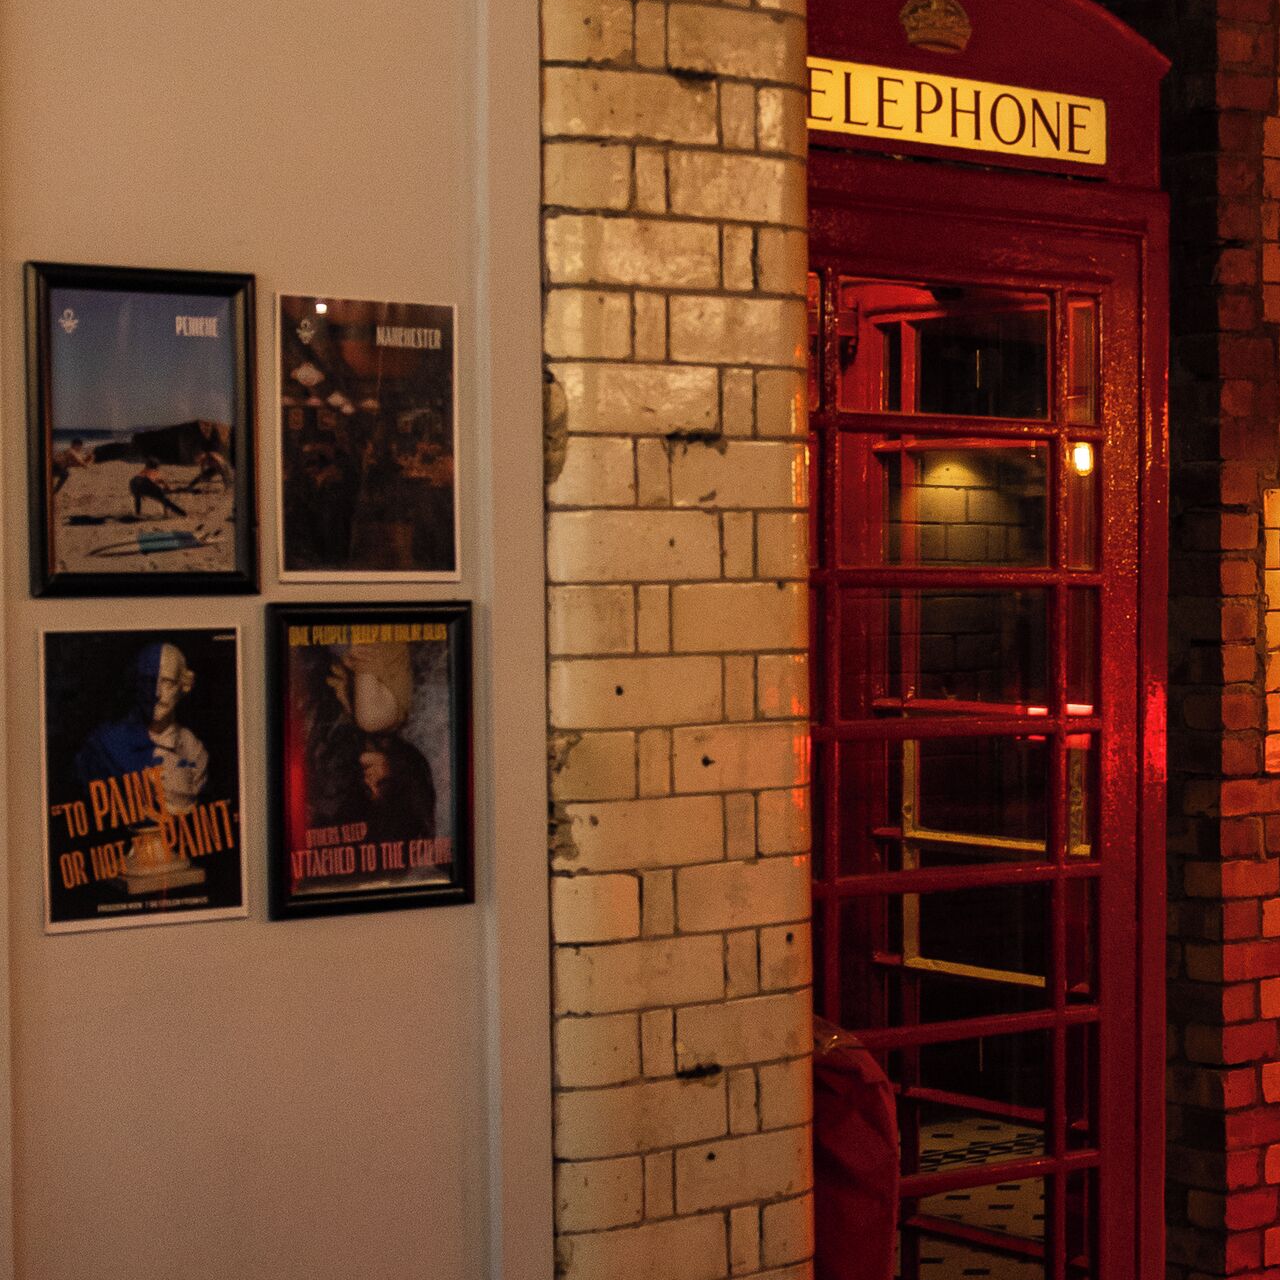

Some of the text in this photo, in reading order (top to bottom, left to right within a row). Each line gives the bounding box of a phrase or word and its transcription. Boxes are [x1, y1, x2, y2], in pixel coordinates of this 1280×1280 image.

[807, 66, 1092, 155] ELEPHONE
[376, 325, 441, 350] MANCHESTER
[88, 766, 164, 832] PAINT
[59, 850, 89, 890] OR
[89, 839, 129, 881] NOT
[290, 846, 355, 880] ATTACHED
[359, 843, 377, 872] TO
[380, 841, 406, 870] THE
